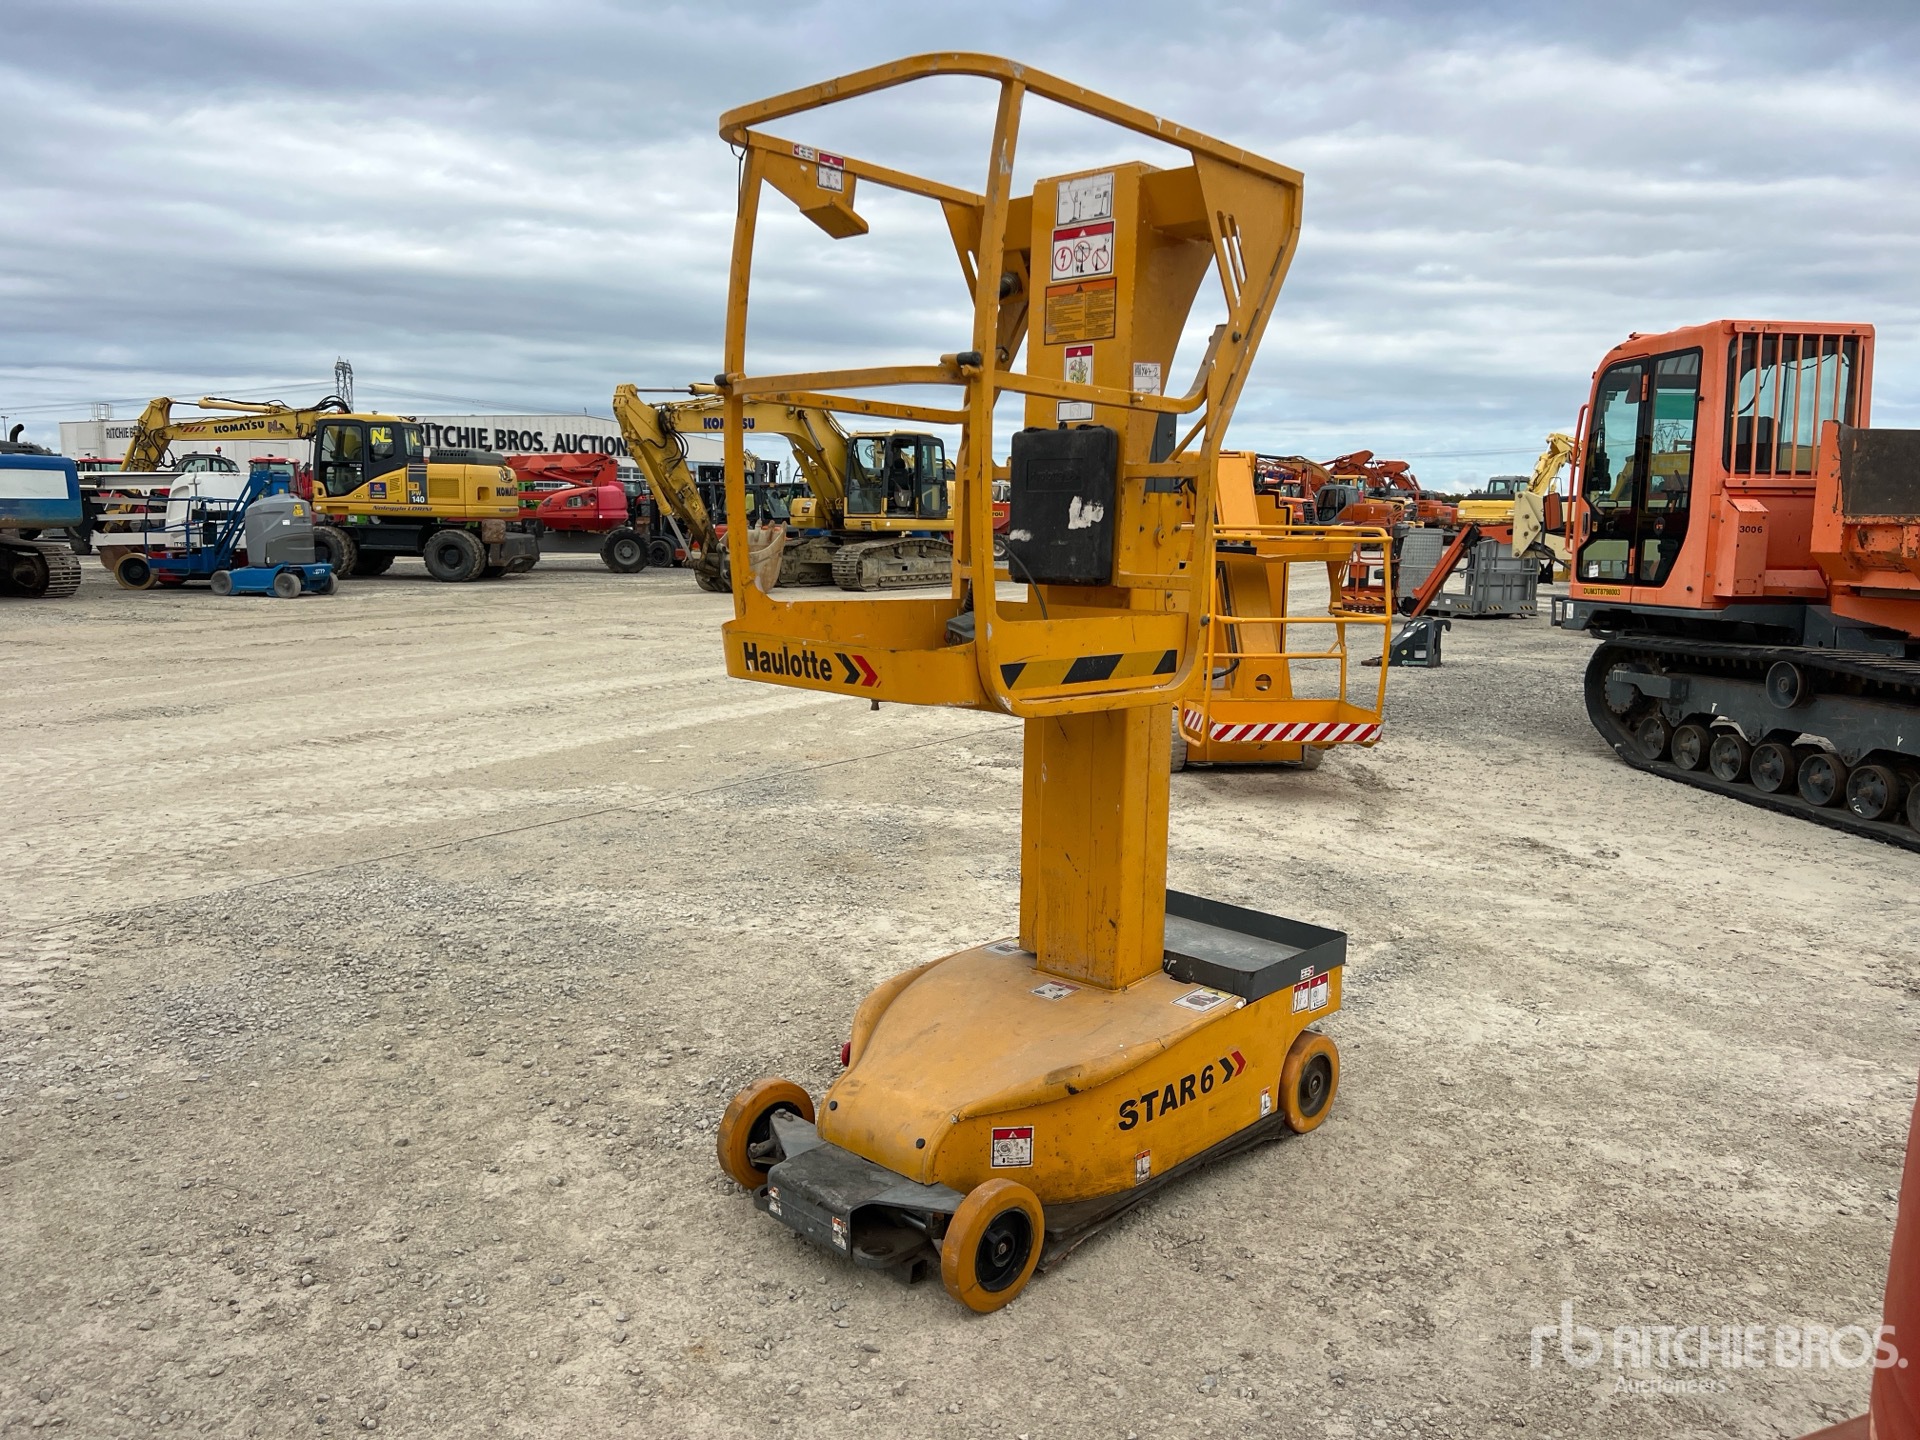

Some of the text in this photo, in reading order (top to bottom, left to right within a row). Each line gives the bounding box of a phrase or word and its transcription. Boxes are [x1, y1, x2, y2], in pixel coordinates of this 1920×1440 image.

[213, 420, 265, 434] KOMATSU
[703, 417, 755, 430] KOSU
[106, 427, 129, 438] RITCHIE
[494, 428, 548, 452] BROS.
[411, 495, 425, 504] 140
[1739, 525, 1763, 534] 3006
[743, 641, 833, 682] Haulotte
